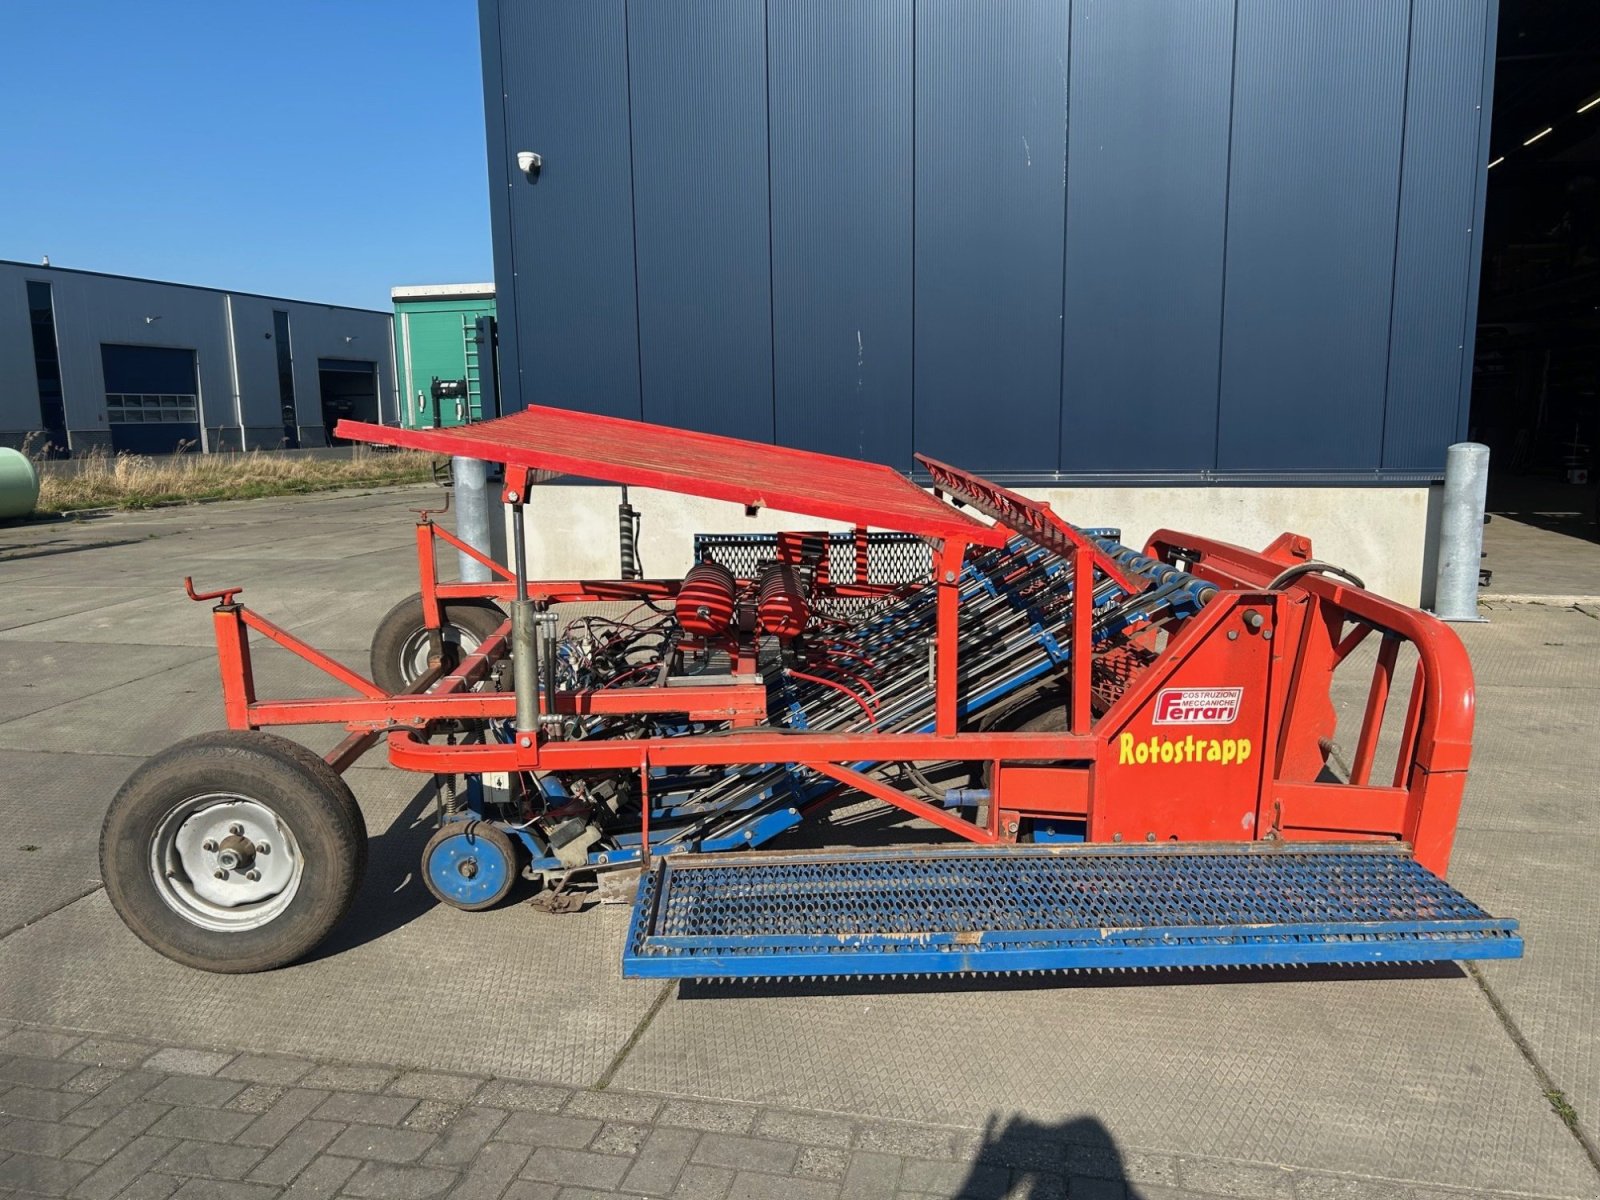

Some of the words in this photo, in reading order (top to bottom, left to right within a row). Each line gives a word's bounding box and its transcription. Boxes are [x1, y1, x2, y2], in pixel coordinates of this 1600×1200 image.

[1158, 692, 1234, 720] Ferrari
[1181, 699, 1236, 707] MECCANICHE
[1119, 732, 1252, 765] Rotostrapp
